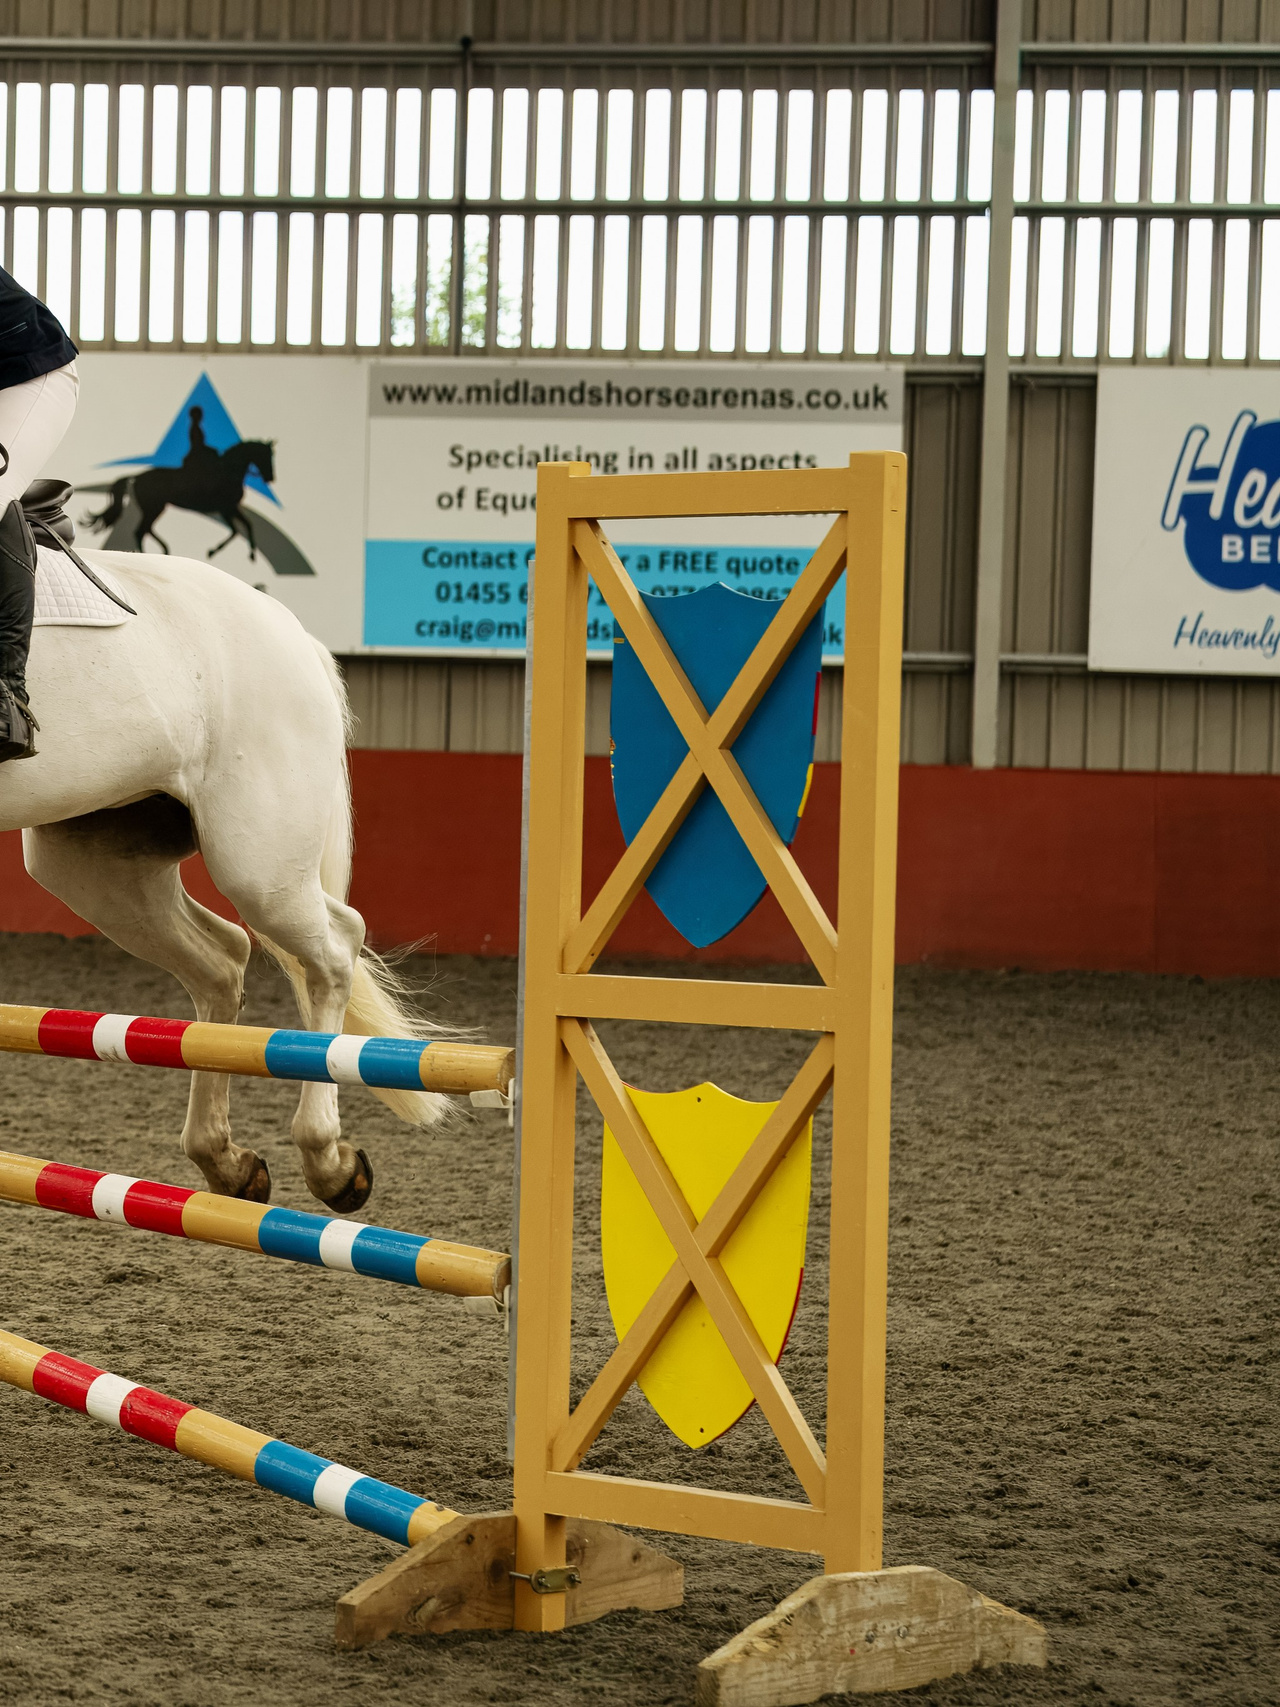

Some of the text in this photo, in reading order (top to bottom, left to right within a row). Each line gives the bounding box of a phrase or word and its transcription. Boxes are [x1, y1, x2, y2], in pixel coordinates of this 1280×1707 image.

[382, 378, 889, 411] www.midlandshorsearenas.co.uk
[449, 444, 818, 474] Specialising in all aspects
[436, 486, 466, 511] of
[422, 547, 518, 570] Contact
[636, 555, 651, 572] a
[658, 551, 719, 573] FREE
[726, 553, 801, 577] quote
[435, 581, 512, 604] 01455
[1173, 611, 1280, 660] Heavenly
